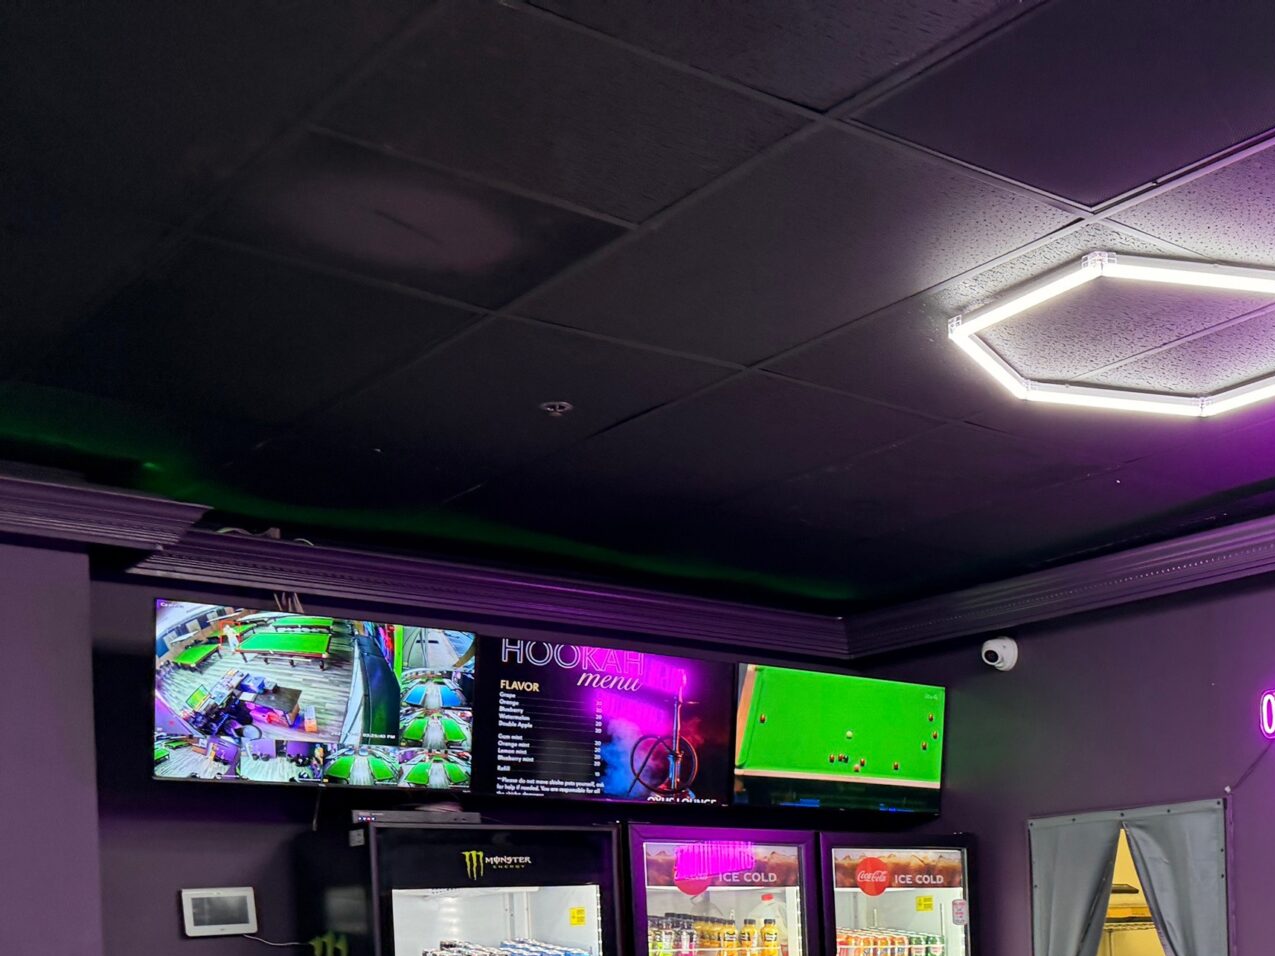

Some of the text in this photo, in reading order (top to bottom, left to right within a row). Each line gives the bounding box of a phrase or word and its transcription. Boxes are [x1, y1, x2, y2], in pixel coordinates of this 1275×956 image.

[501, 638, 644, 676] HOOKAH
[500, 679, 540, 693] FLAVOR
[577, 672, 641, 692] menu
[498, 706, 524, 714] Blueberry
[498, 713, 530, 721] Watermelon
[498, 740, 518, 748] Orange
[485, 856, 532, 864] MONSTER
[718, 872, 740, 882] ICE
[744, 872, 777, 882] COLD
[894, 874, 944, 884] ICE COLD
